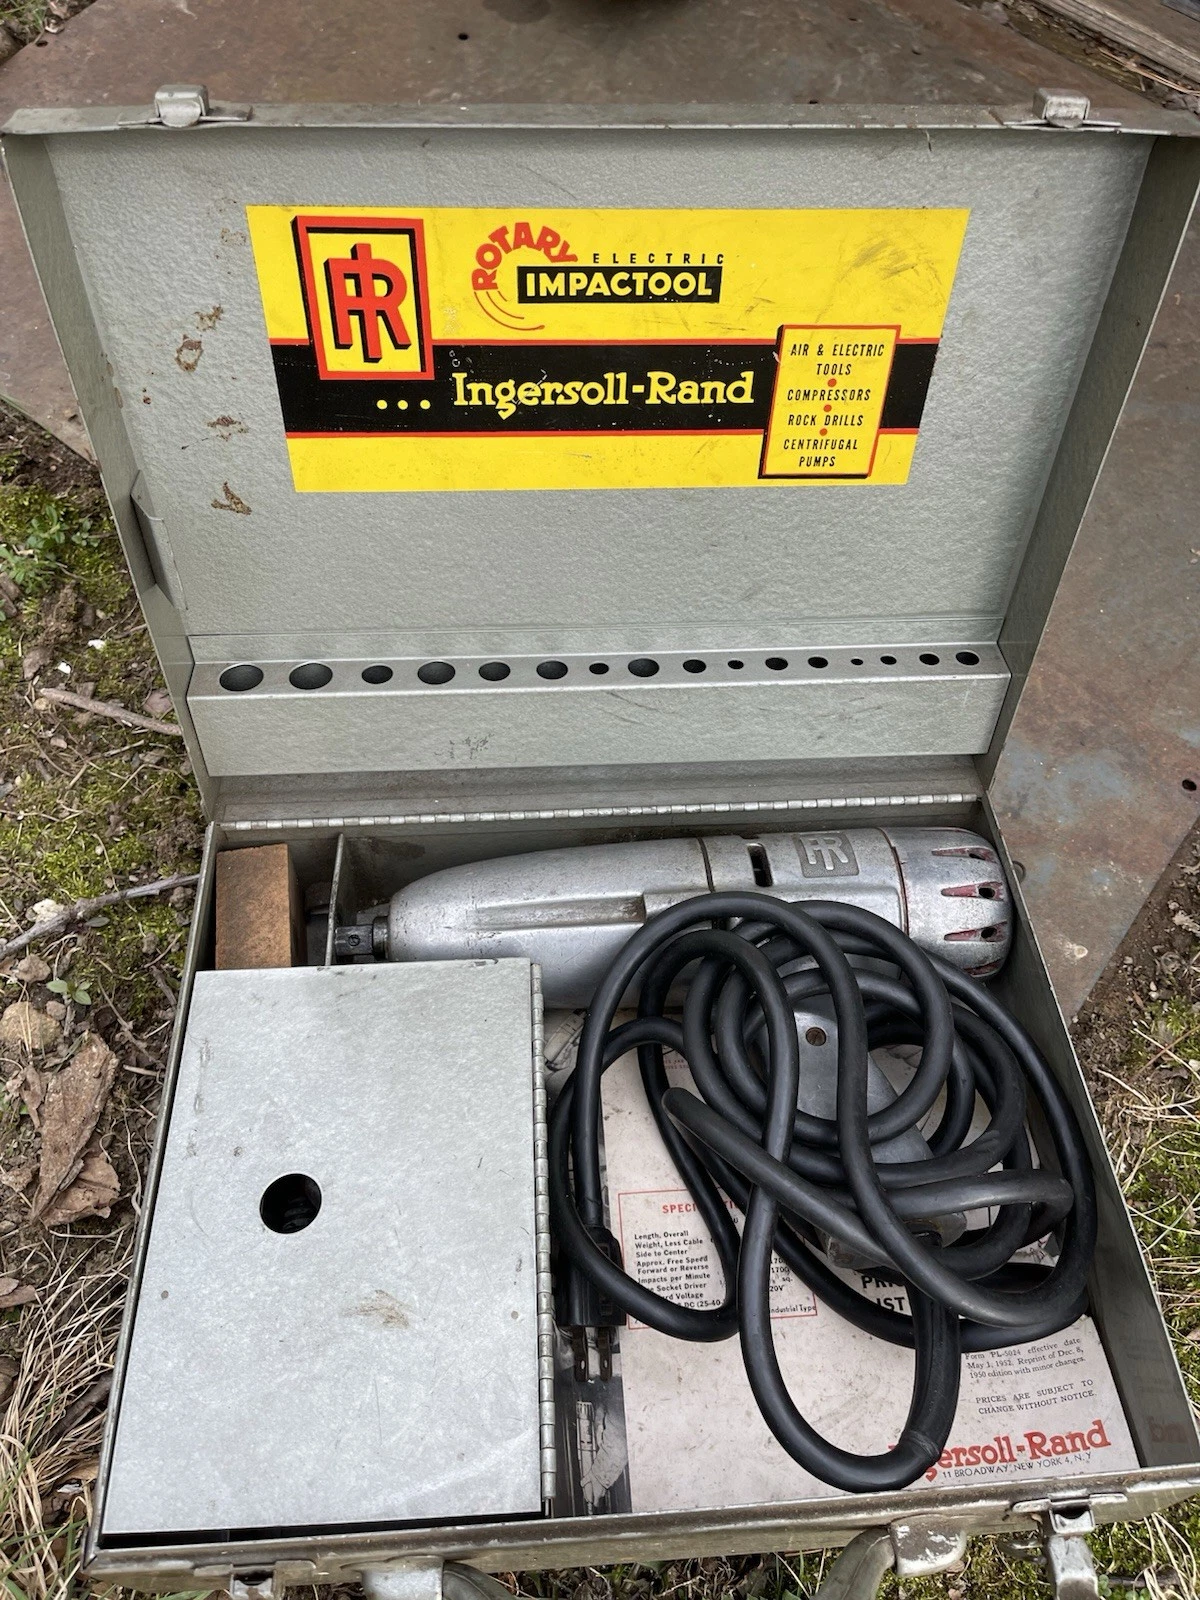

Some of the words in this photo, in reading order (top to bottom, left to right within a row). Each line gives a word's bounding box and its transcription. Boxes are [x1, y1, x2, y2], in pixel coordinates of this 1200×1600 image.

[471, 222, 578, 291] ROTARY
[593, 253, 724, 264] ELECTRIC
[526, 271, 713, 297] IMPACTOOL
[790, 343, 809, 356] AIR
[817, 343, 824, 356] &
[832, 343, 885, 357] ELECTRIC
[816, 363, 852, 375] TOOLS
[452, 371, 755, 420] Ingersoll-Rand
[787, 389, 871, 401] COMPRESSORS
[788, 414, 816, 426] ROCK
[824, 414, 864, 426] DRILLS
[783, 439, 858, 450] CENTRIFUGAL
[798, 456, 836, 467] PUMPS
[663, 1230, 689, 1238] Overall
[635, 1241, 663, 1249] Weight,
[683, 1238, 703, 1246] Cable
[636, 1250, 652, 1258] Side
[637, 1260, 665, 1269] Approx.
[667, 1257, 683, 1265] Free
[685, 1255, 708, 1265] Speed
[637, 1266, 668, 1275] Forward
[680, 1264, 709, 1272] Reverse
[638, 1276, 668, 1284] Impacts
[685, 1272, 711, 1280] Minute
[656, 1283, 682, 1292] Socket
[684, 1282, 707, 1290] Driver
[675, 1292, 704, 1300] Voltage
[770, 1305, 798, 1313] ndustrial
[799, 1304, 816, 1313] Type
[876, 1296, 905, 1311] IST
[965, 1352, 985, 1360] Form
[1027, 1343, 1058, 1354] effective
[1063, 1338, 1080, 1347] date
[967, 1362, 984, 1370] May
[1017, 1355, 1046, 1366] Reprint
[1047, 1351, 1056, 1360] of
[1057, 1349, 1075, 1358] Dec.
[969, 1371, 987, 1379] 1950
[987, 1369, 1013, 1377] edition
[1013, 1367, 1031, 1375] with
[1032, 1364, 1054, 1372] minor
[1055, 1356, 1086, 1368] changes.
[975, 1395, 1007, 1404] PRICES
[1012, 1392, 1031, 1401] ARE
[1036, 1383, 1075, 1397] SUBJECT
[1081, 1379, 1094, 1387] TO
[978, 1405, 1015, 1415] CHANGE
[1016, 1397, 1058, 1411] WITHOUT
[1060, 1389, 1097, 1403] NOTICE.
[888, 1419, 1111, 1482] ersoll-Rand
[942, 1470, 951, 1479] 11
[1014, 1461, 1034, 1471] NEW
[1037, 1457, 1062, 1468] YORK
